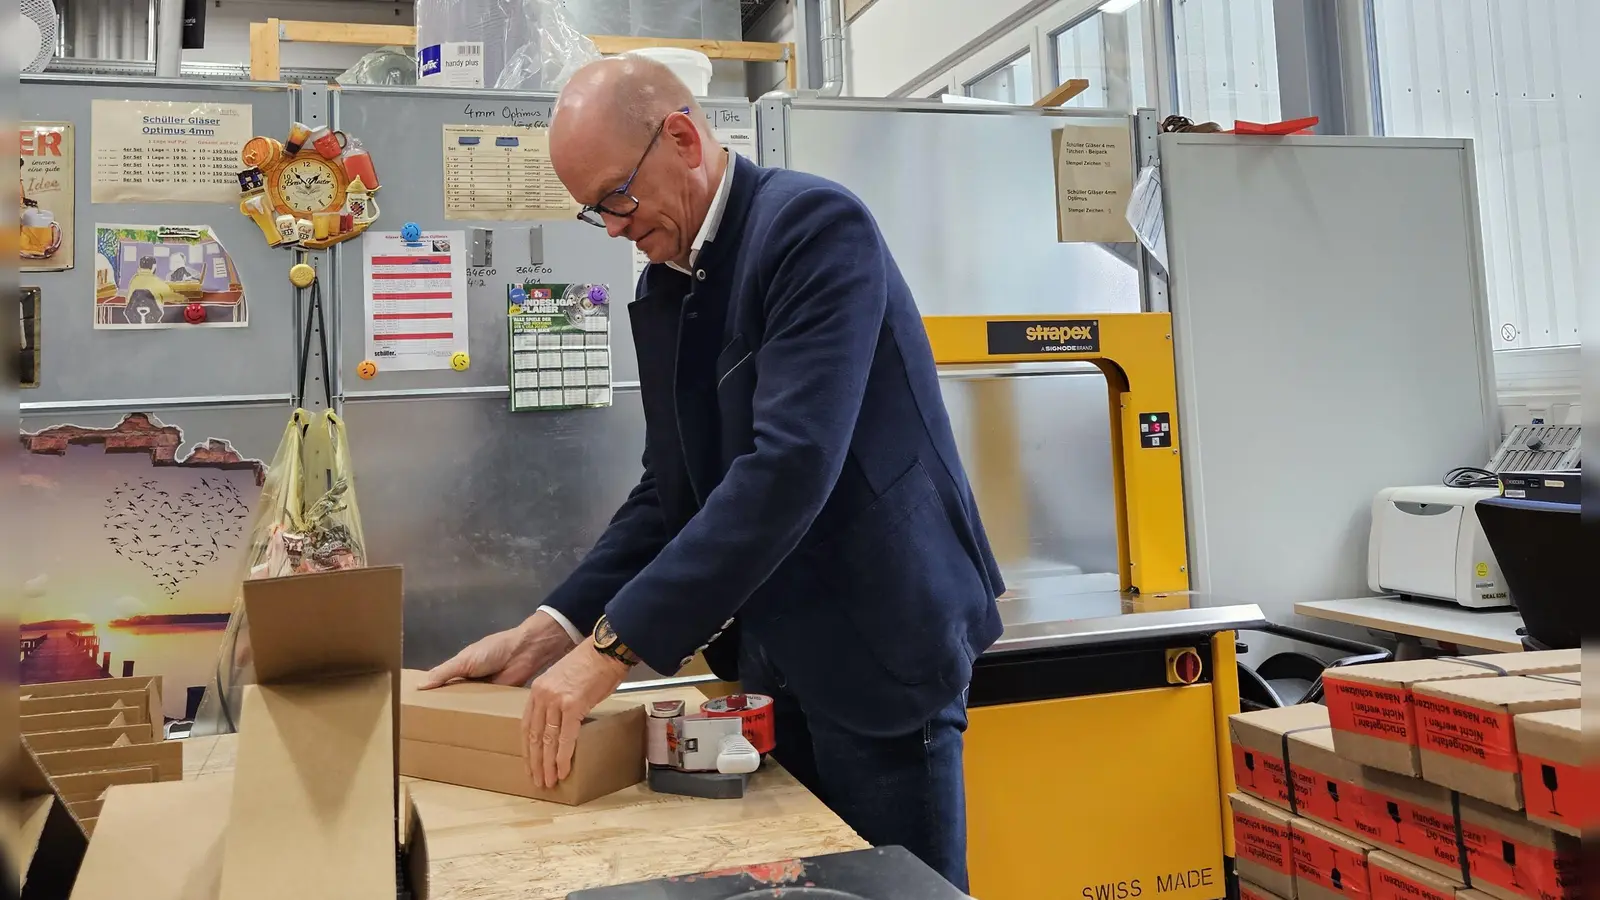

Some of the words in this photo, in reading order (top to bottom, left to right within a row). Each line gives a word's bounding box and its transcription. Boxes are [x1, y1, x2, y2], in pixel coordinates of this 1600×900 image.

[446, 59, 463, 67] handy
[465, 59, 479, 67] plus
[464, 103, 496, 118] 4mm
[502, 105, 541, 121] Optimus
[142, 115, 184, 124] Schüller
[188, 116, 221, 126] Gläser
[142, 126, 186, 136] Optimus
[188, 127, 215, 136] 4mm
[44, 167, 60, 175] gute
[26, 177, 60, 192] Idee
[522, 299, 576, 307] UNDESLIGA-
[1026, 325, 1092, 344] strapex
[1340, 686, 1373, 699] schützen
[1376, 692, 1401, 704] Nässe
[1355, 702, 1380, 714] werfen
[1382, 708, 1404, 720] Nicht
[1453, 707, 1480, 724] Nässe
[1359, 718, 1406, 737] Bruchgefahr
[1430, 719, 1458, 732] werfen
[1482, 716, 1500, 730] Vor
[1460, 726, 1484, 742] Nicht
[1432, 735, 1486, 759] Bruchgefahr
[1263, 760, 1284, 774] Handle
[1299, 774, 1312, 784] care
[1261, 824, 1279, 837] Nässe
[1412, 810, 1440, 829] Handle
[1463, 829, 1482, 842] care
[1247, 833, 1264, 844] werfen
[1426, 828, 1437, 840] Do
[1266, 840, 1282, 852] Nicht
[1248, 847, 1283, 866] Bruchgefahr
[1302, 852, 1312, 862] Do
[1434, 846, 1455, 864] Keep
[1298, 862, 1321, 879] Handle
[1082, 880, 1142, 900] SWISS
[1156, 868, 1213, 893] MADE
[1384, 874, 1419, 895] schützen
